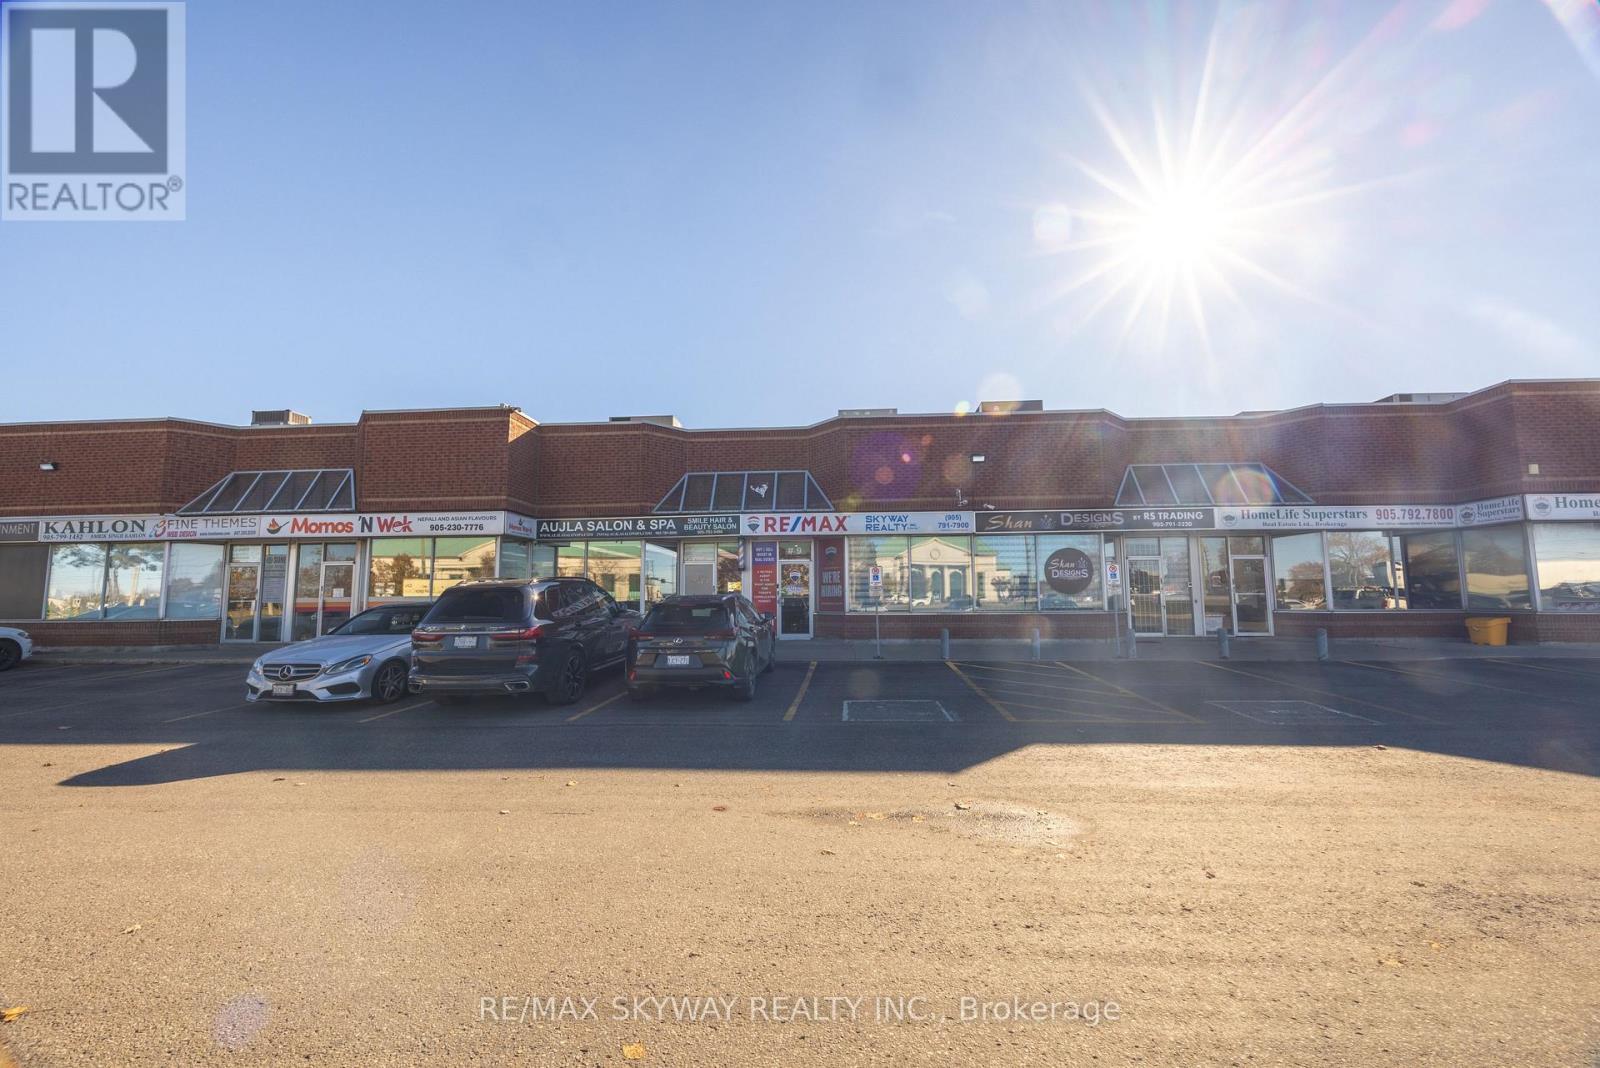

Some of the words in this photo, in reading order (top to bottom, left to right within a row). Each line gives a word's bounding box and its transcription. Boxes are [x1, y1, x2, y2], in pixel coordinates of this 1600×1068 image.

[1143, 512, 1156, 520] RS
[1158, 511, 1204, 520] TRADING
[1240, 508, 1300, 520] HomeLife
[1302, 508, 1368, 522] Superstars
[1376, 508, 1454, 520] 905.792.7800
[44, 520, 146, 534] KAHLON
[167, 520, 198, 529] FINE
[202, 518, 256, 528] THEMES
[290, 518, 354, 534] Momos
[540, 522, 584, 532] AUJLA
[586, 520, 632, 531] SALON
[637, 520, 646, 530] &
[650, 519, 676, 530] SPA
[764, 516, 848, 532] RE/MAX
[984, 514, 1032, 531] Shan
[1060, 512, 1124, 526] DESIGNS
[866, 524, 908, 532] REALTY
[1048, 558, 1075, 569] Shan
[1052, 569, 1088, 578] DESIGNS
